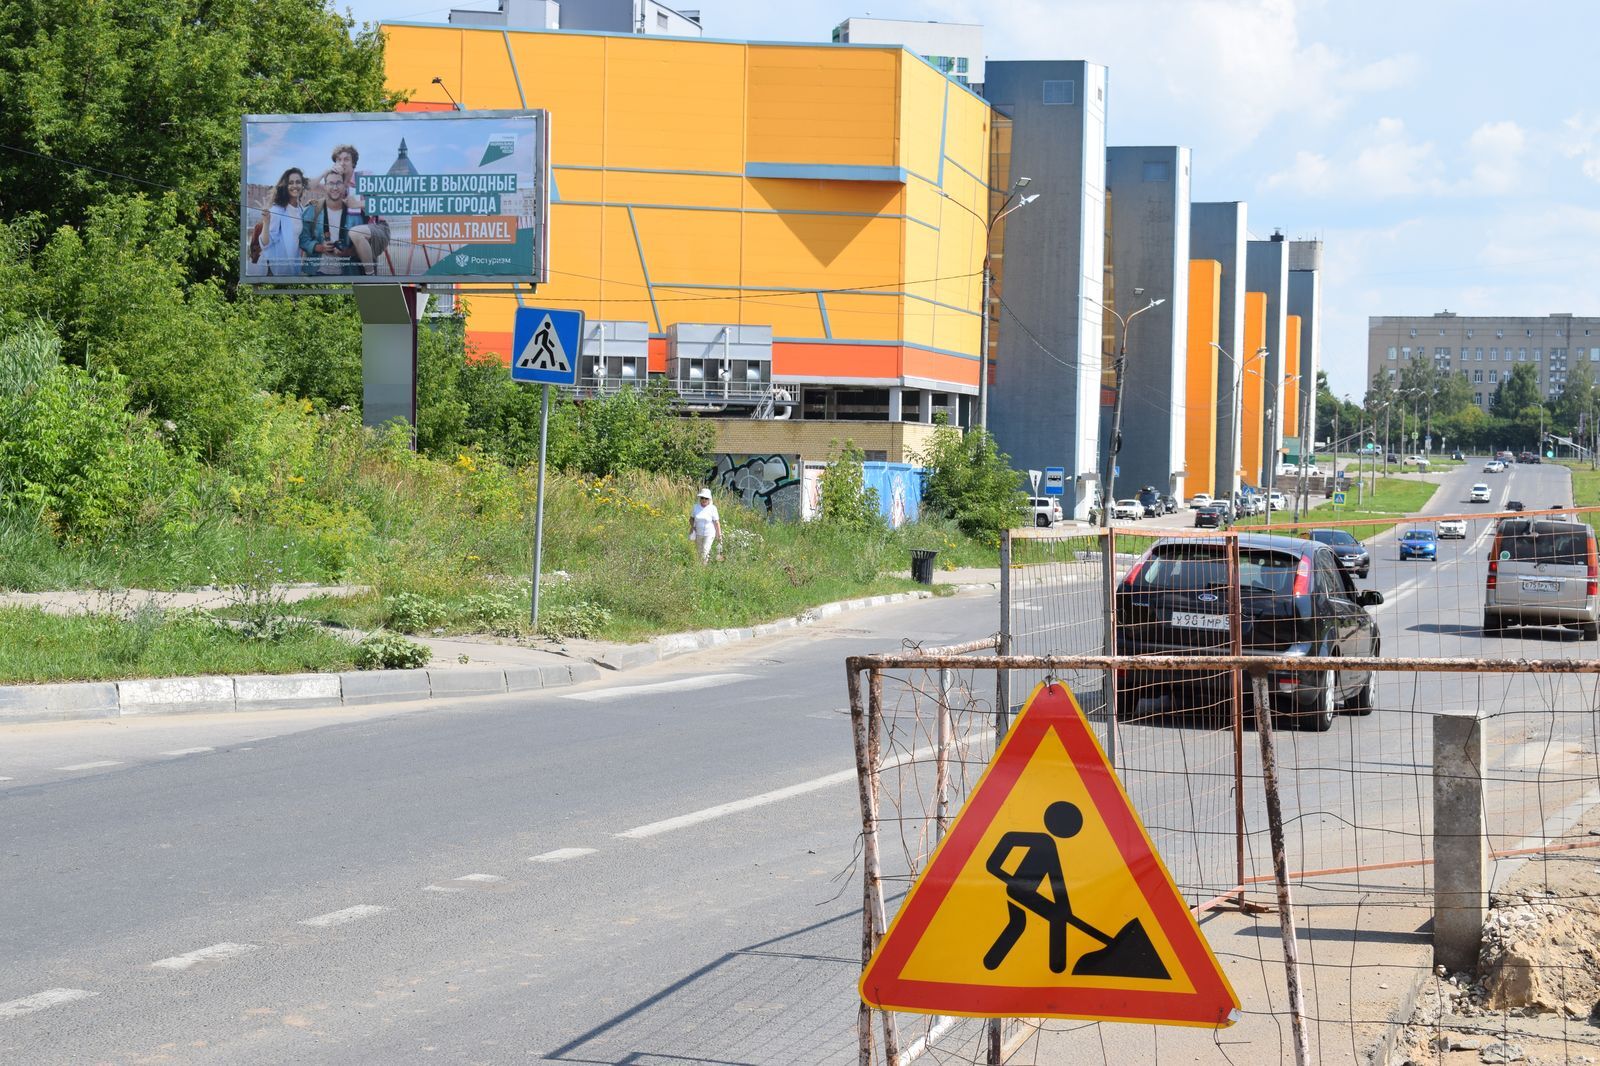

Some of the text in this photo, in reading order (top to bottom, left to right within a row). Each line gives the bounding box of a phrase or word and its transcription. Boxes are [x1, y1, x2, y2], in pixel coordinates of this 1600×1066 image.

[359, 175, 516, 194] ВЫХОДИТЕ В ВЫХОДНЫЕ
[368, 196, 497, 215] В СОСЕДНИЕ ГОРОДА
[417, 222, 511, 239] RUSSIA.TRAVEL
[471, 256, 511, 266] Ростуризм
